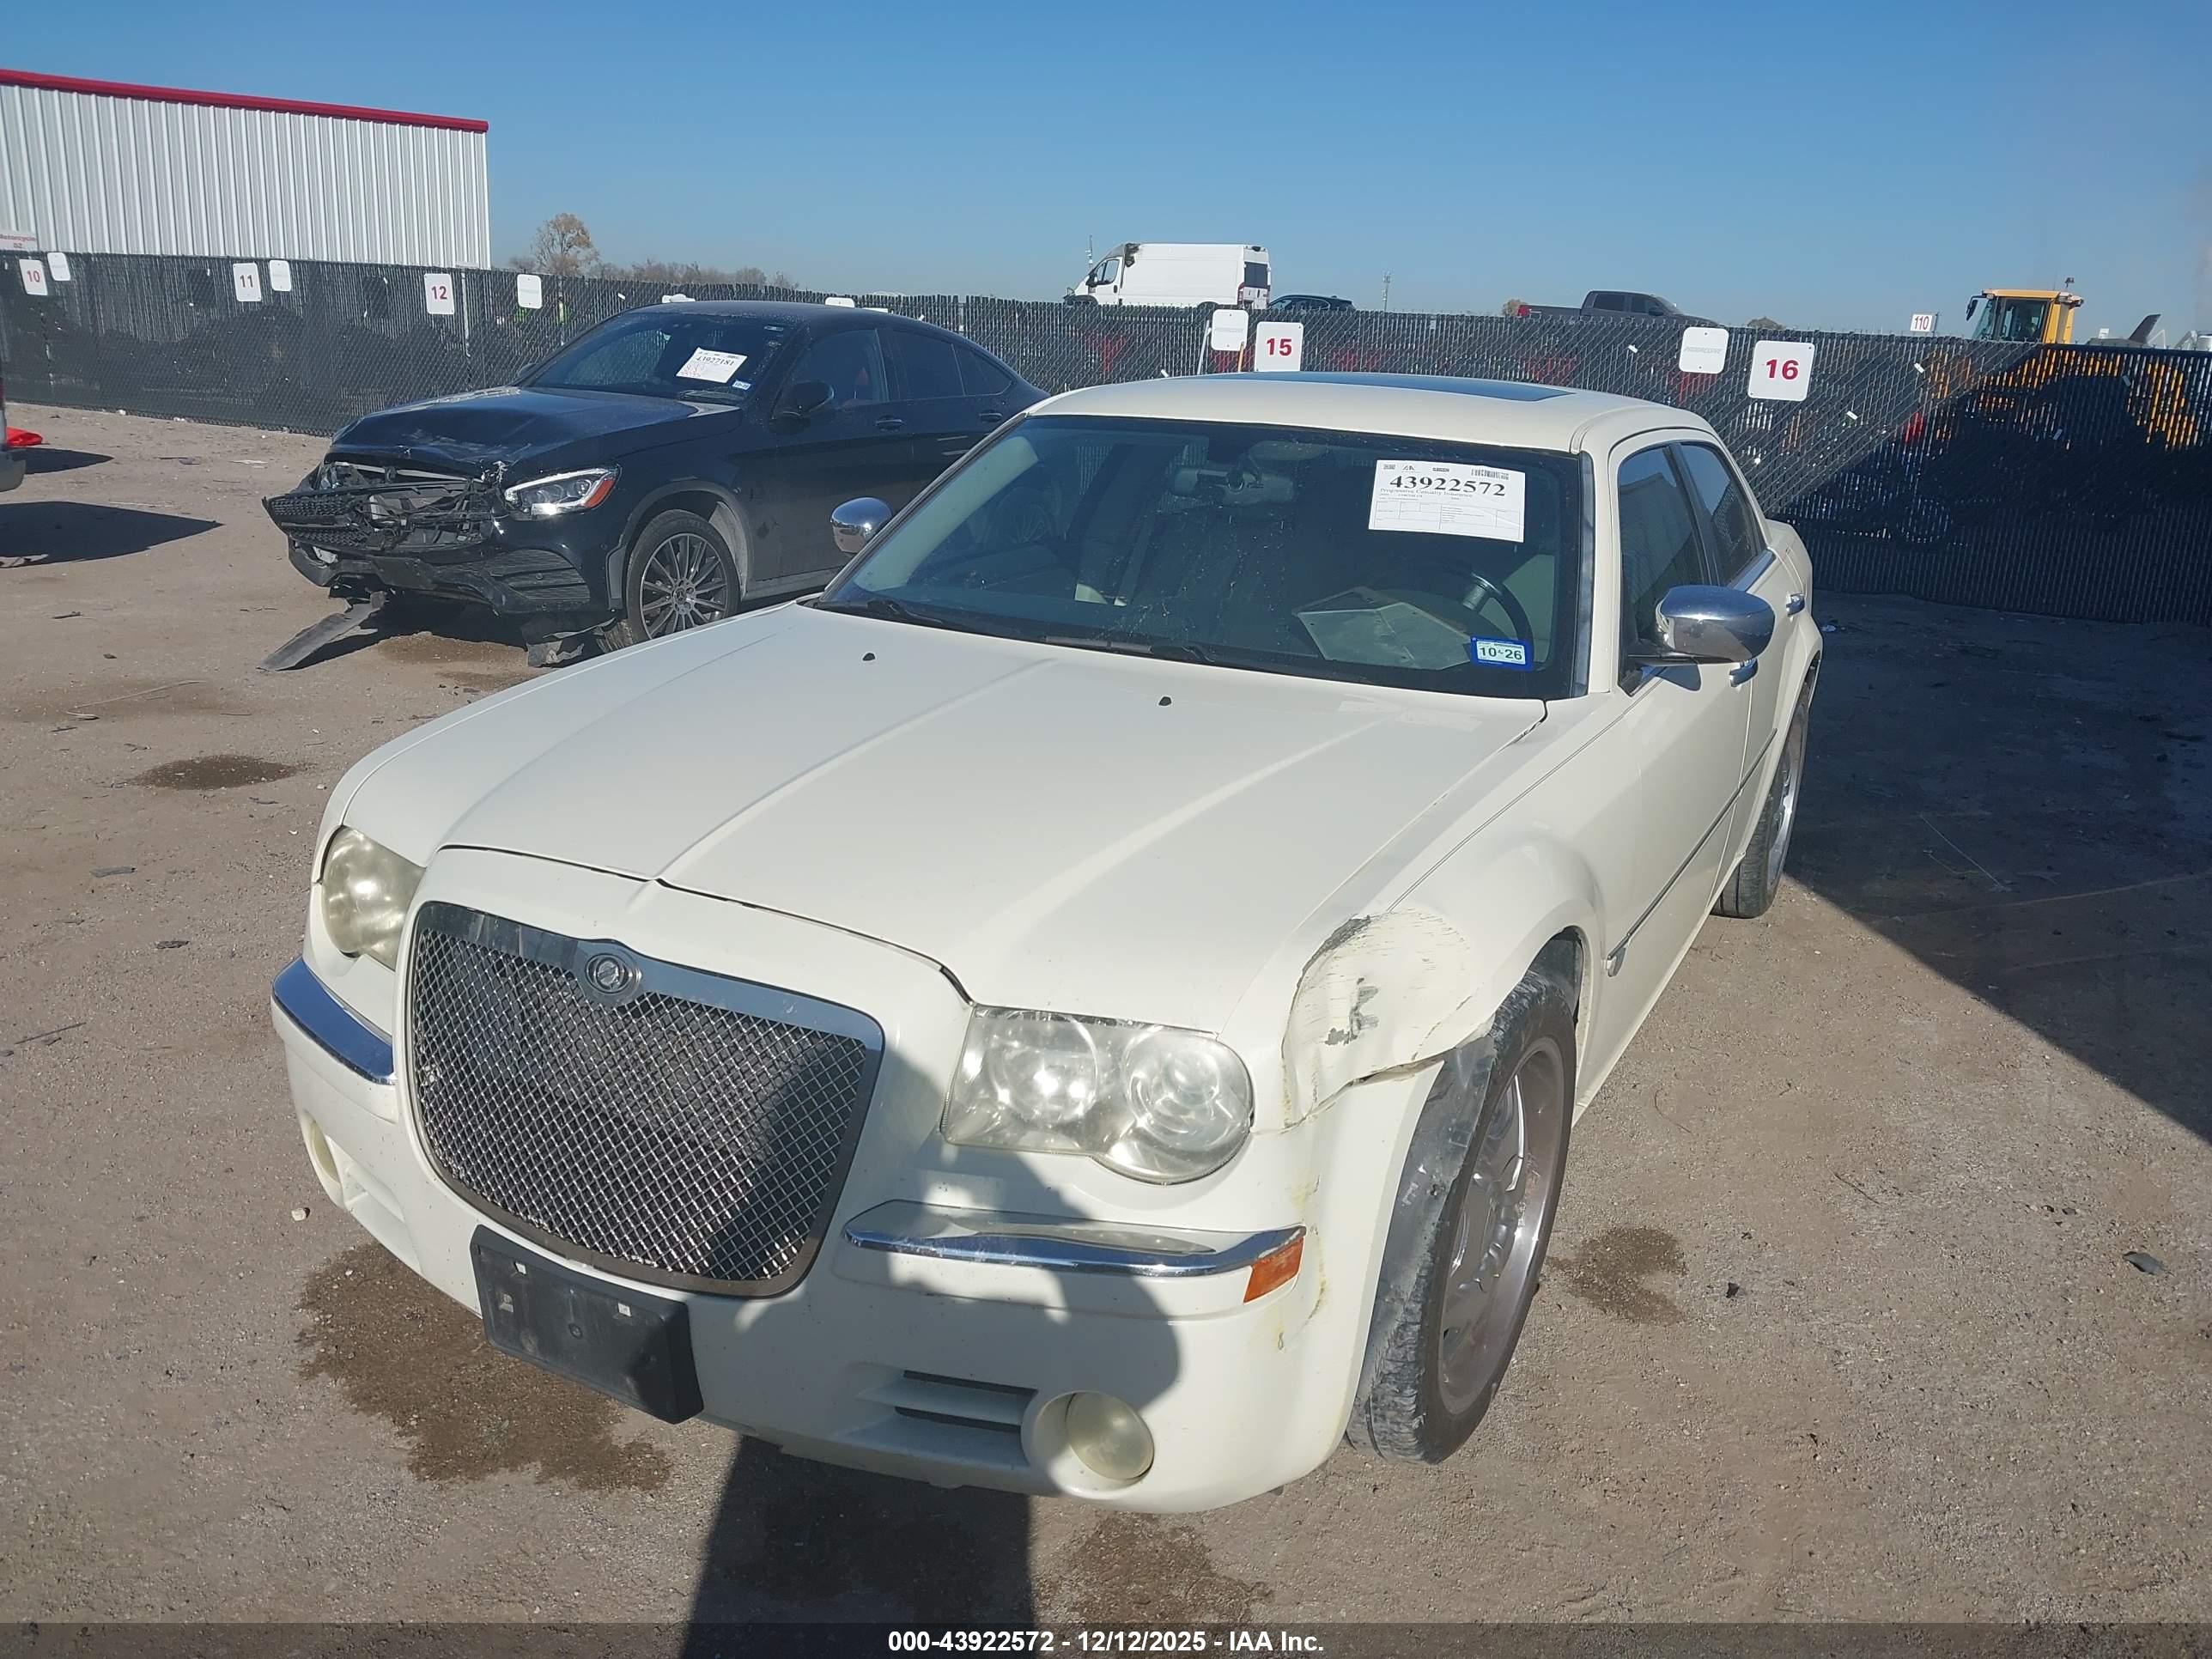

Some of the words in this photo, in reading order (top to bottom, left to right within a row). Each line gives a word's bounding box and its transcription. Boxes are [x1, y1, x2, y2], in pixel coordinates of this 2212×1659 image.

[27, 270, 40, 283] 10
[240, 275, 253, 289] 11
[431, 286, 447, 300] 12
[1914, 315, 1929, 330] 110
[1266, 338, 1292, 356] 15
[1765, 359, 1799, 380] 16
[1389, 475, 1506, 497] 43922572
